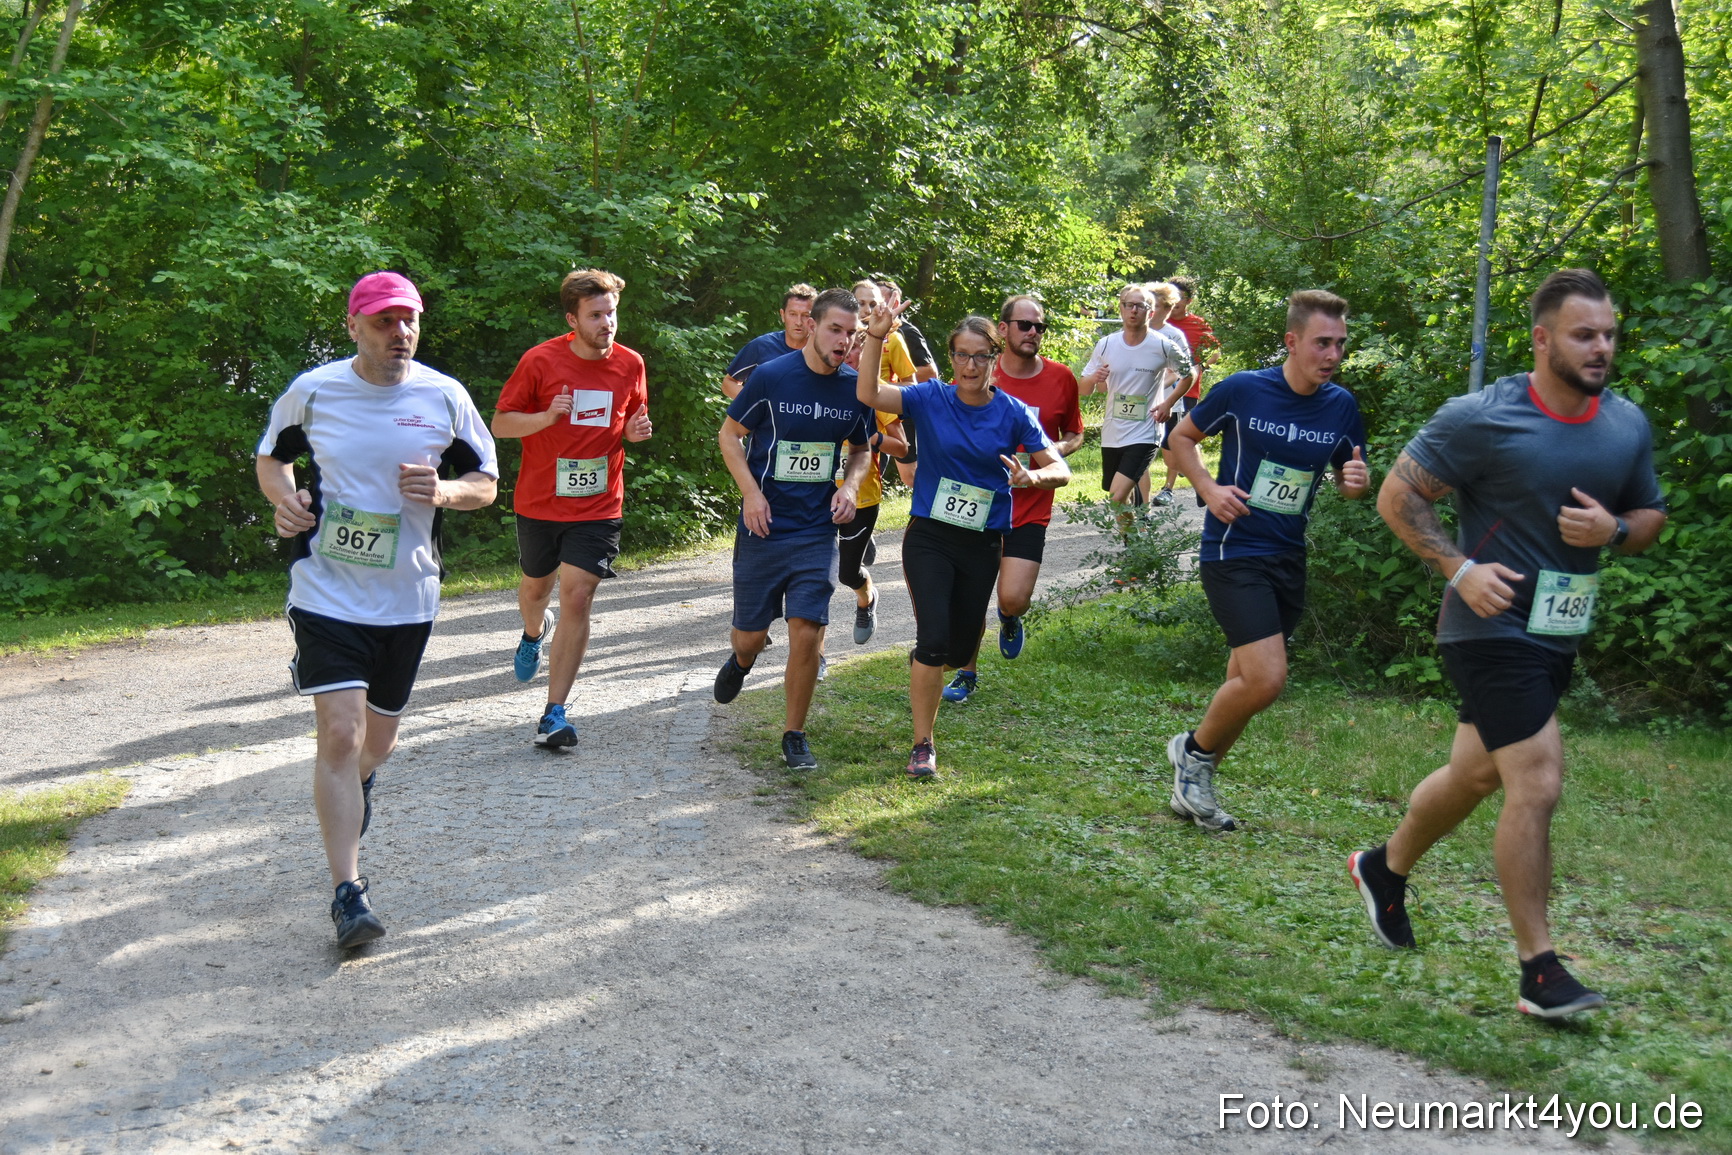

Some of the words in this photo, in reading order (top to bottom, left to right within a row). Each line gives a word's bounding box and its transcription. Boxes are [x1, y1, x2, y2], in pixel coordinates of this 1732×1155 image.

[779, 401, 813, 416] EURO
[823, 406, 853, 421] POLES
[1121, 403, 1136, 414] 37
[1248, 416, 1287, 437] EURO
[1298, 428, 1336, 444] POLES
[788, 456, 821, 471] 709
[568, 471, 598, 487] 553
[1266, 480, 1301, 503] 704
[945, 496, 978, 518] 873
[335, 525, 382, 552] 967
[328, 543, 359, 556] Zachmeier
[359, 551, 385, 560] Manfred
[1544, 594, 1590, 619] 1488
